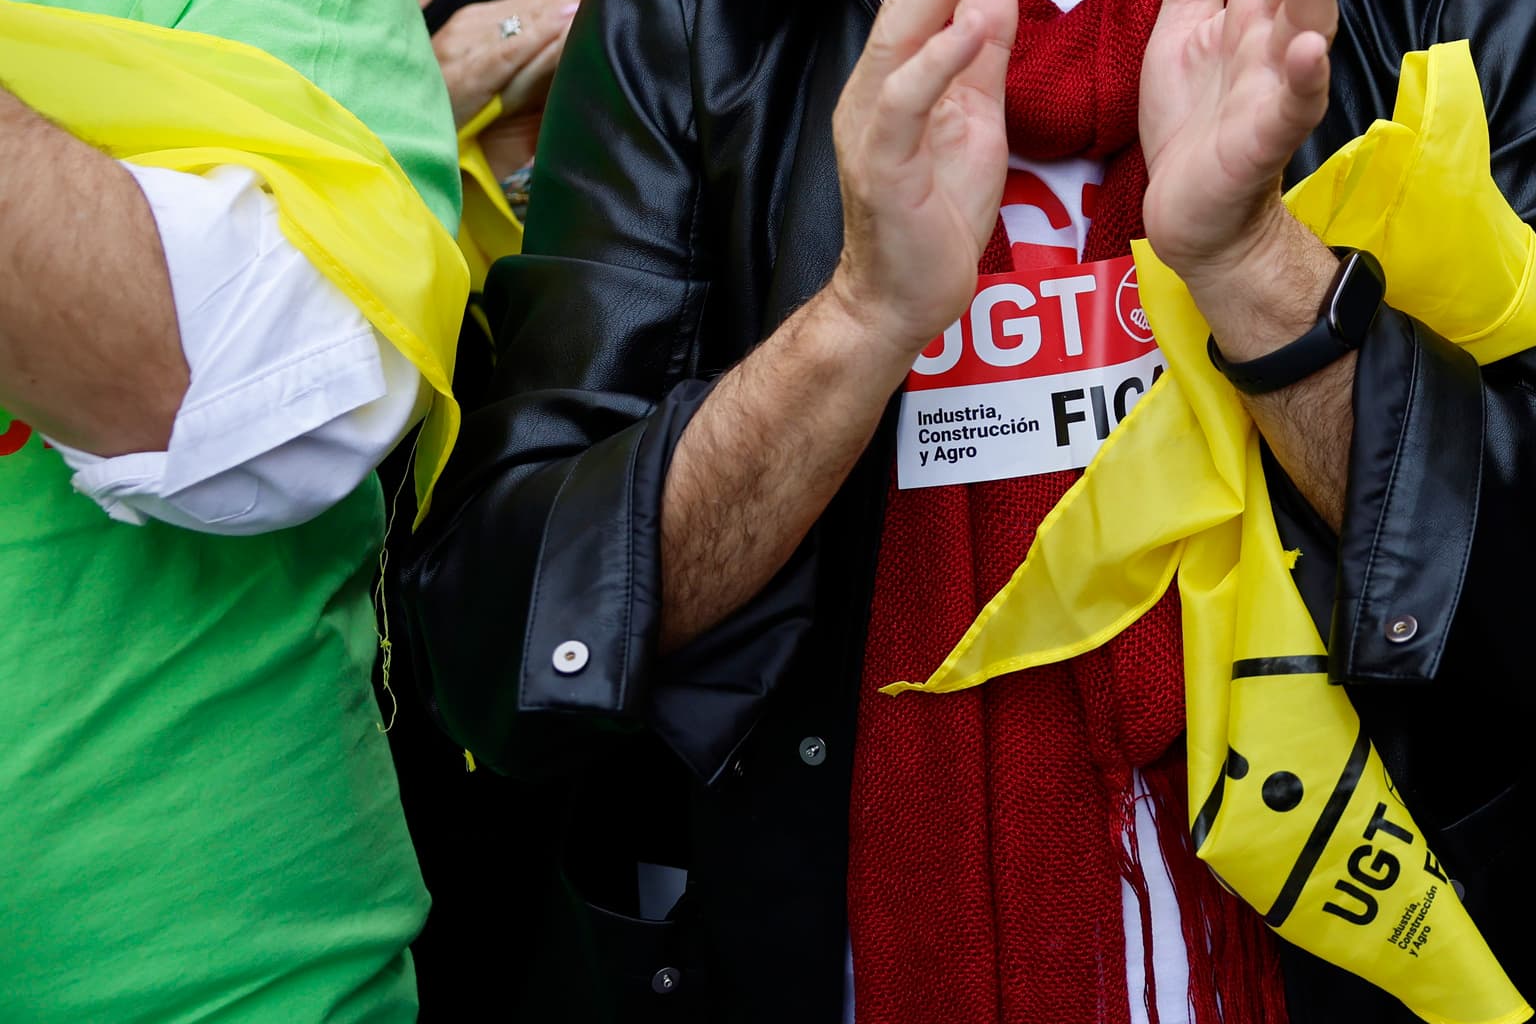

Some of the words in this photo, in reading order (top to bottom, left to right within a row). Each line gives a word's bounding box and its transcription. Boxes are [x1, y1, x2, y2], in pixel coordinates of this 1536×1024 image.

[918, 404, 1002, 426] Industria,
[1051, 364, 1164, 447] FIC
[918, 417, 1040, 445] Construcción
[919, 449, 929, 467] y
[933, 445, 978, 465] Agro
[1322, 802, 1414, 926] UGT
[1387, 902, 1421, 944] Industria,
[1398, 885, 1438, 950] Construcción
[1412, 925, 1431, 950] Agro
